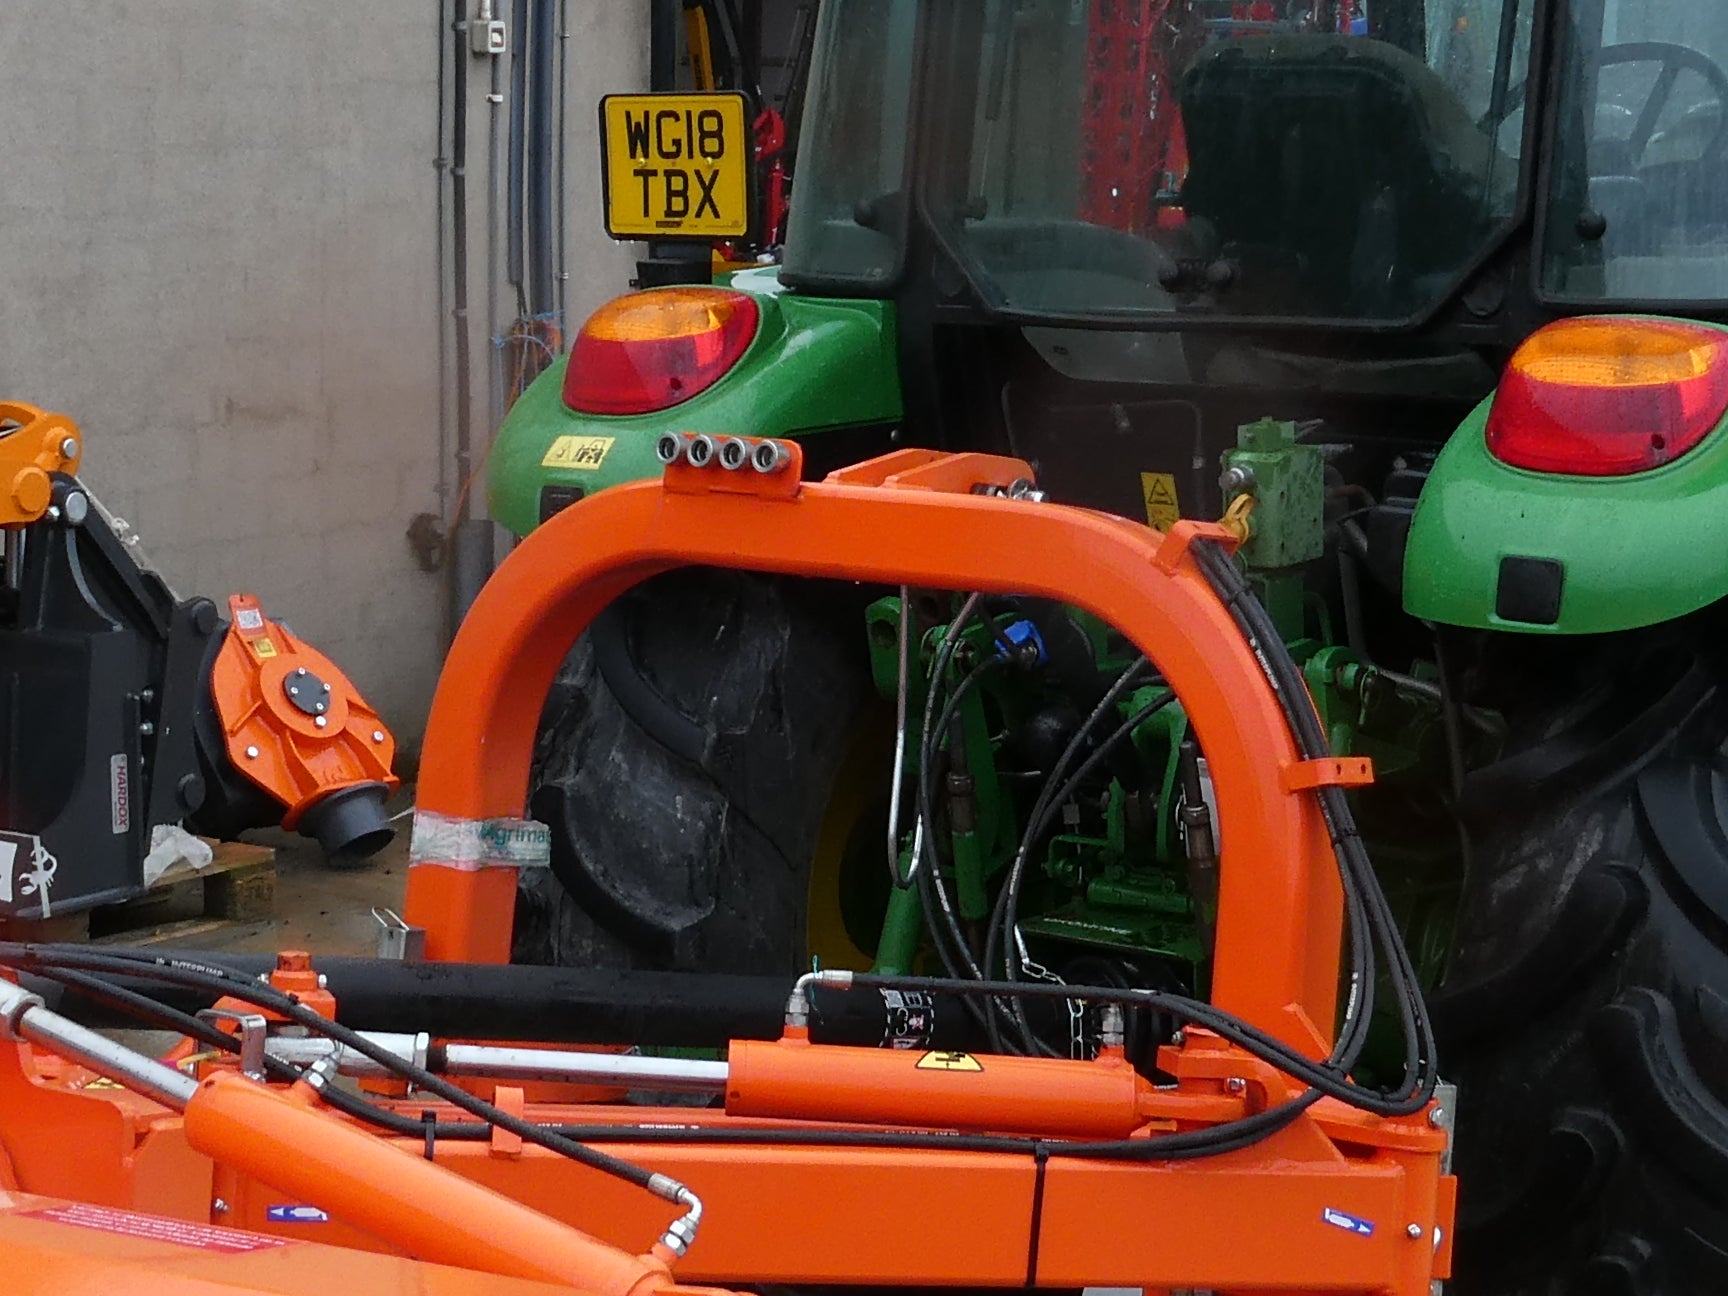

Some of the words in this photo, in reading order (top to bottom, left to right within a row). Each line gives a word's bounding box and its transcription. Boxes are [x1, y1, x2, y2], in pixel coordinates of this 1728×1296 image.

[624, 109, 725, 160] WG18
[632, 168, 721, 219] TBX
[116, 765, 128, 826] HARDOX
